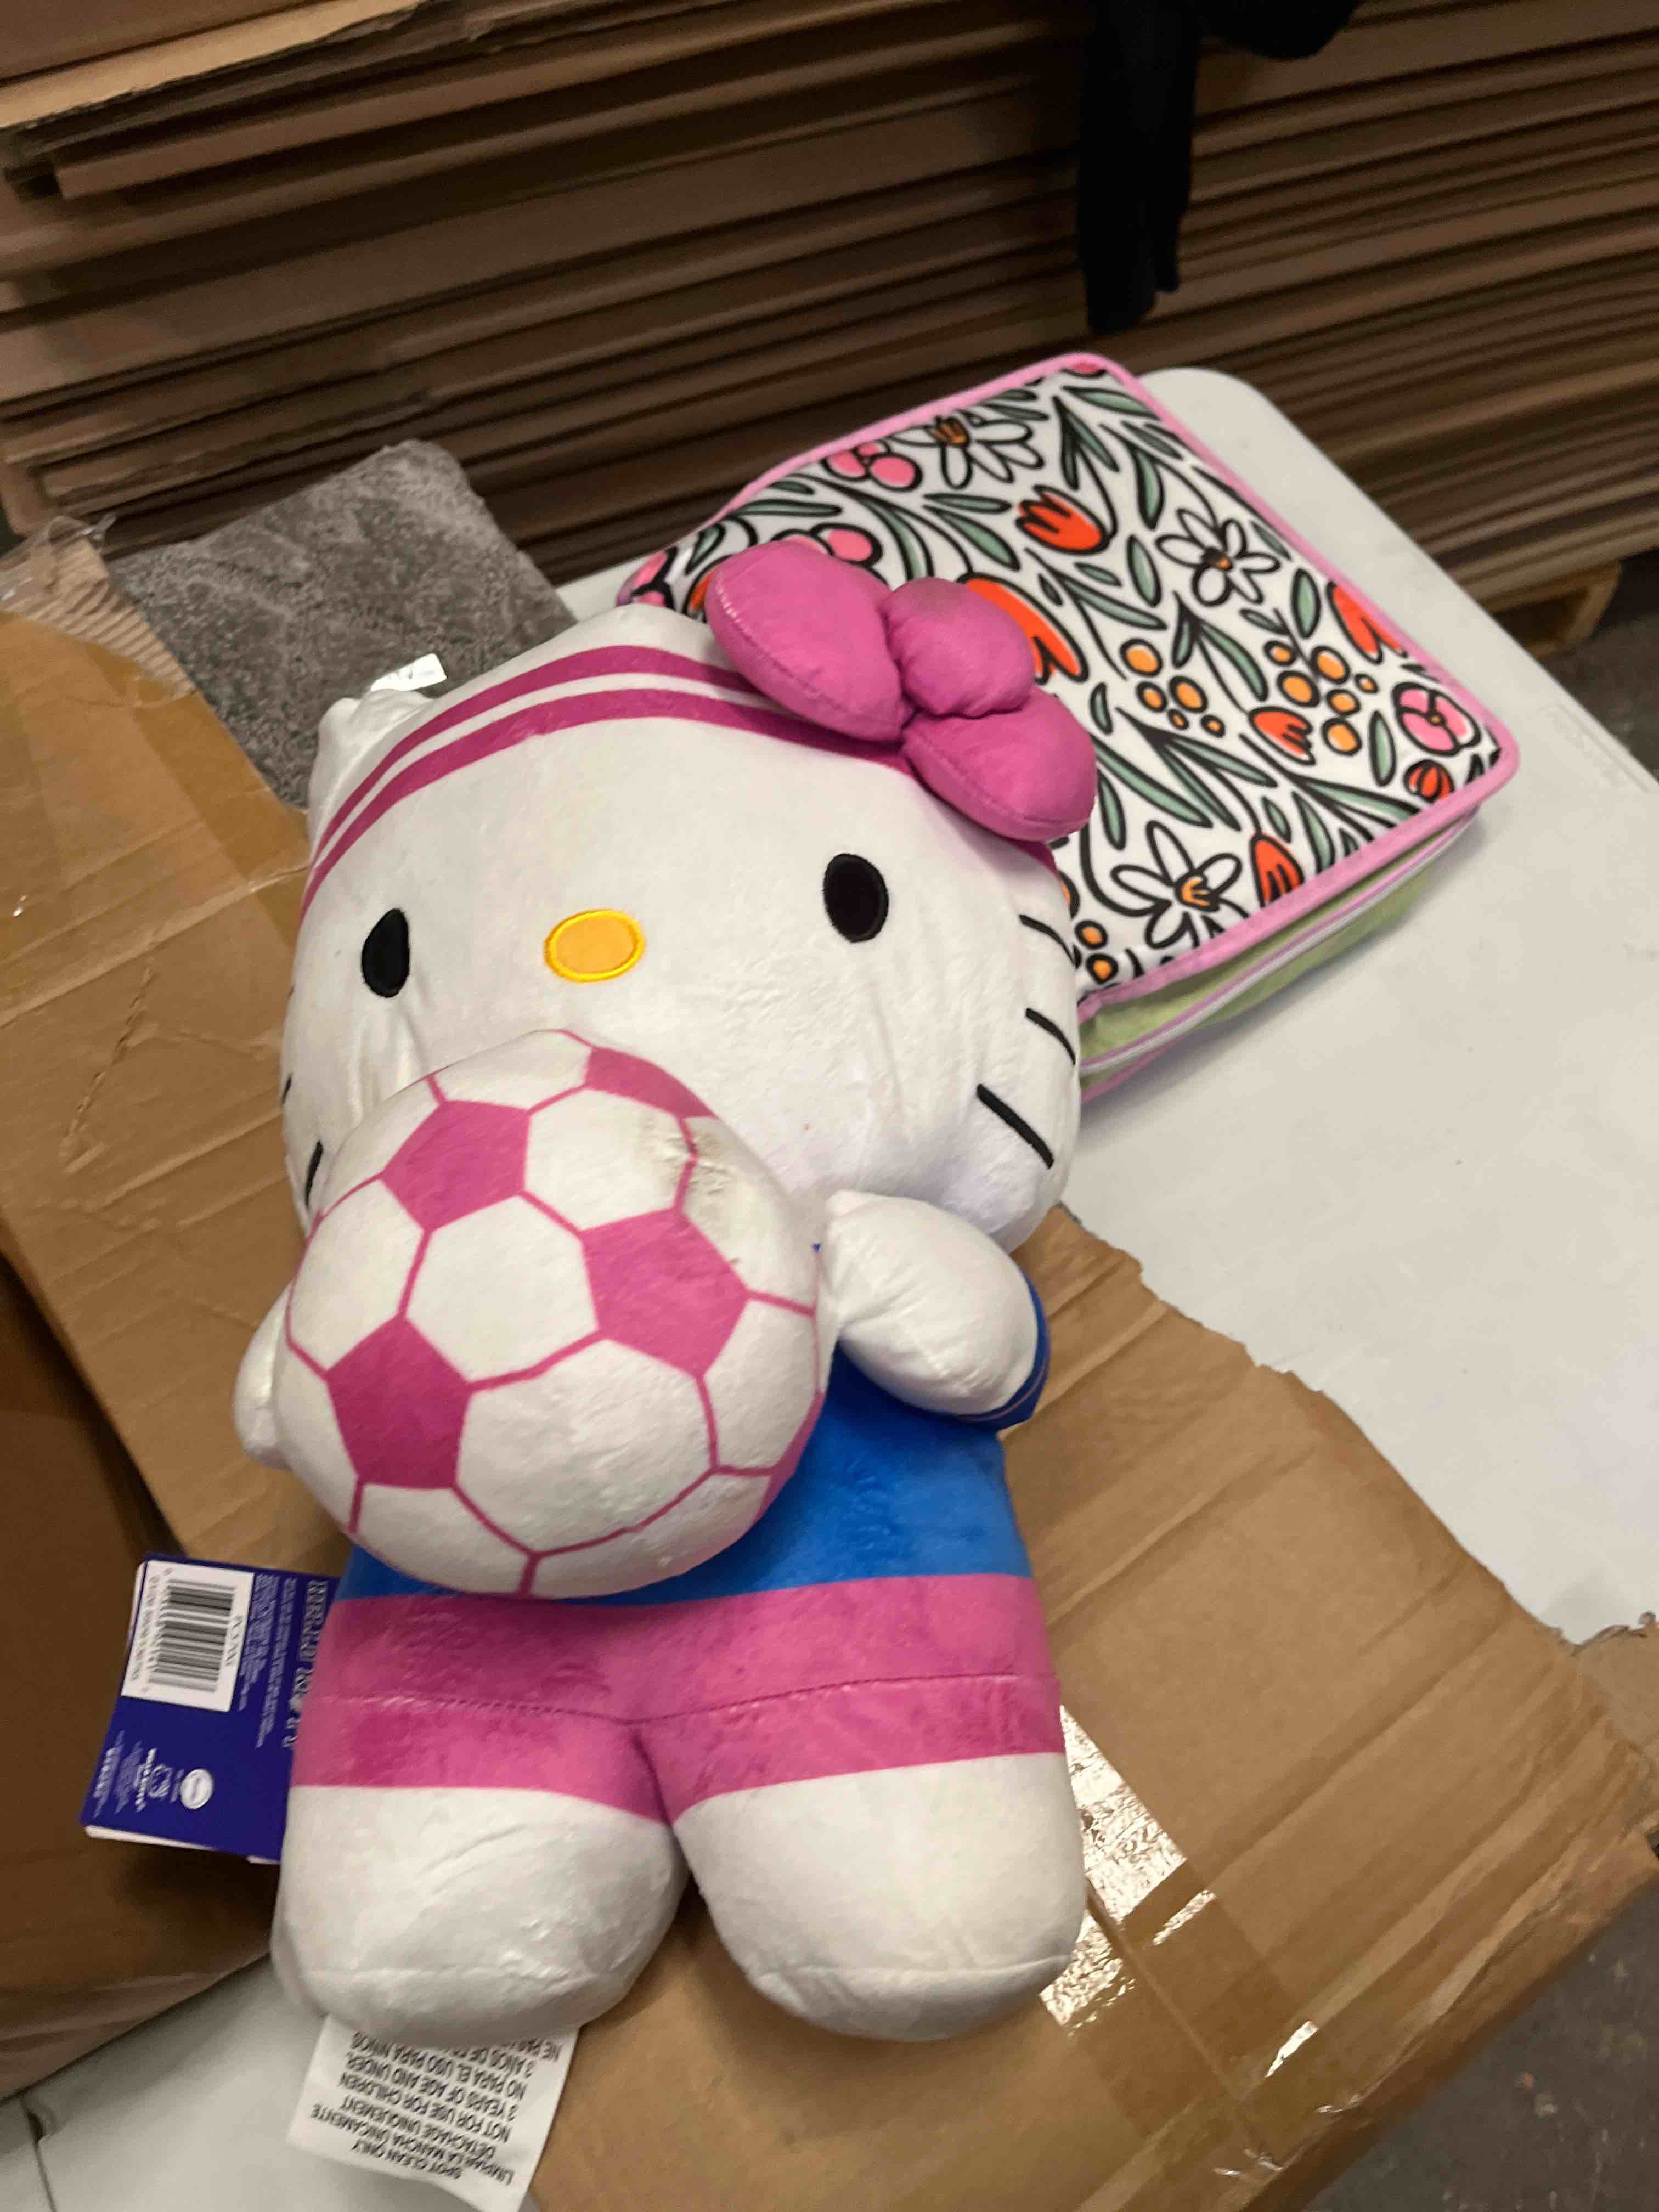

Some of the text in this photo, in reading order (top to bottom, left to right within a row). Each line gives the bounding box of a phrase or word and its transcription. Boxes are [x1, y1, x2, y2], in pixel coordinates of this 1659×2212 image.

[392, 2045, 427, 2069] PARA
[427, 2056, 454, 2079] USO
[392, 2068, 421, 2089] AND
[457, 2064, 472, 2083] EL
[473, 2069, 506, 2094] PARA
[419, 2077, 448, 2098] AGE
[445, 2086, 465, 2104] OF
[507, 2080, 527, 2101] NO
[338, 2073, 512, 2143] NOT FOR USE FOR CHILDREN
[466, 2091, 506, 2118] YEARS
[507, 2104, 518, 2121] 3
[350, 2139, 463, 2179] SPOT CLEAN ONLY
